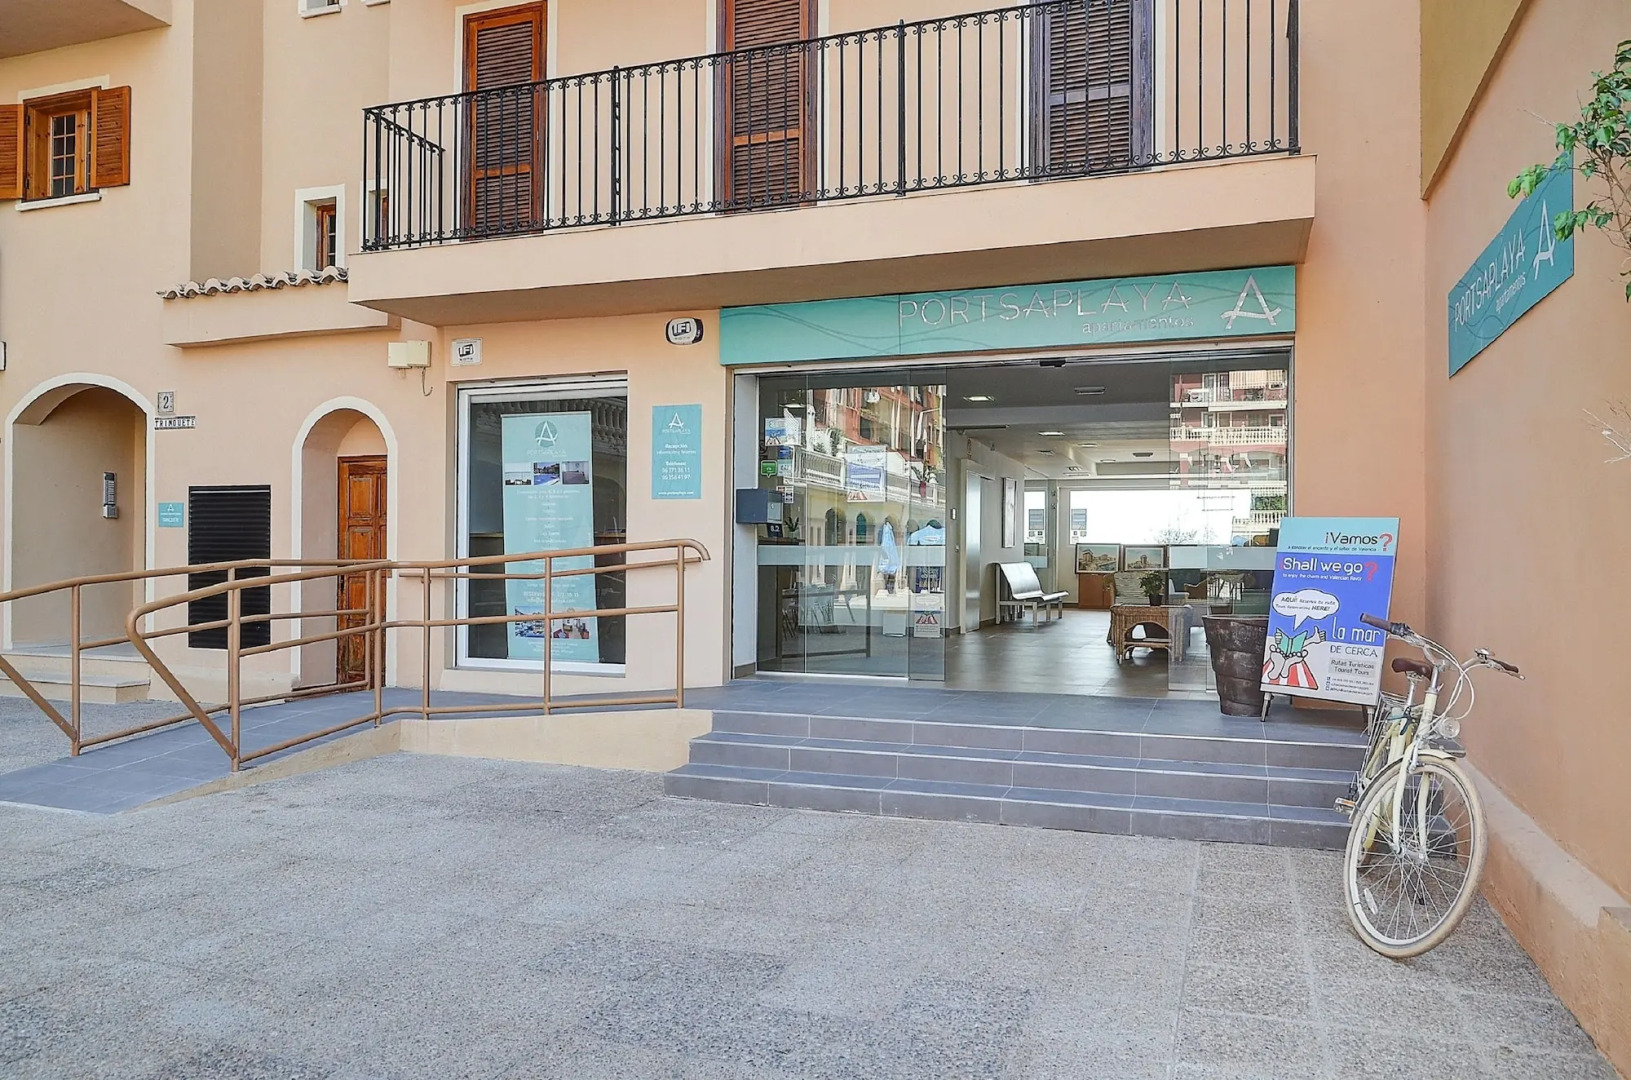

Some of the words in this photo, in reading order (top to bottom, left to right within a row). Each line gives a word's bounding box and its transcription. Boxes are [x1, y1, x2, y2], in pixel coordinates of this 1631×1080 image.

[1454, 228, 1526, 333] PORTSAPLAYA
[900, 281, 1192, 327] PORTSAPLAYA
[1082, 315, 1195, 336] apartamentos
[163, 395, 169, 409] 2
[1320, 562, 1341, 572] we
[1332, 616, 1345, 640] la
[1351, 628, 1381, 642] mar
[1330, 645, 1342, 653] DE
[1344, 646, 1378, 658] CERCA
[1330, 659, 1347, 667] Rutas
[1334, 666, 1353, 674] Tourist
